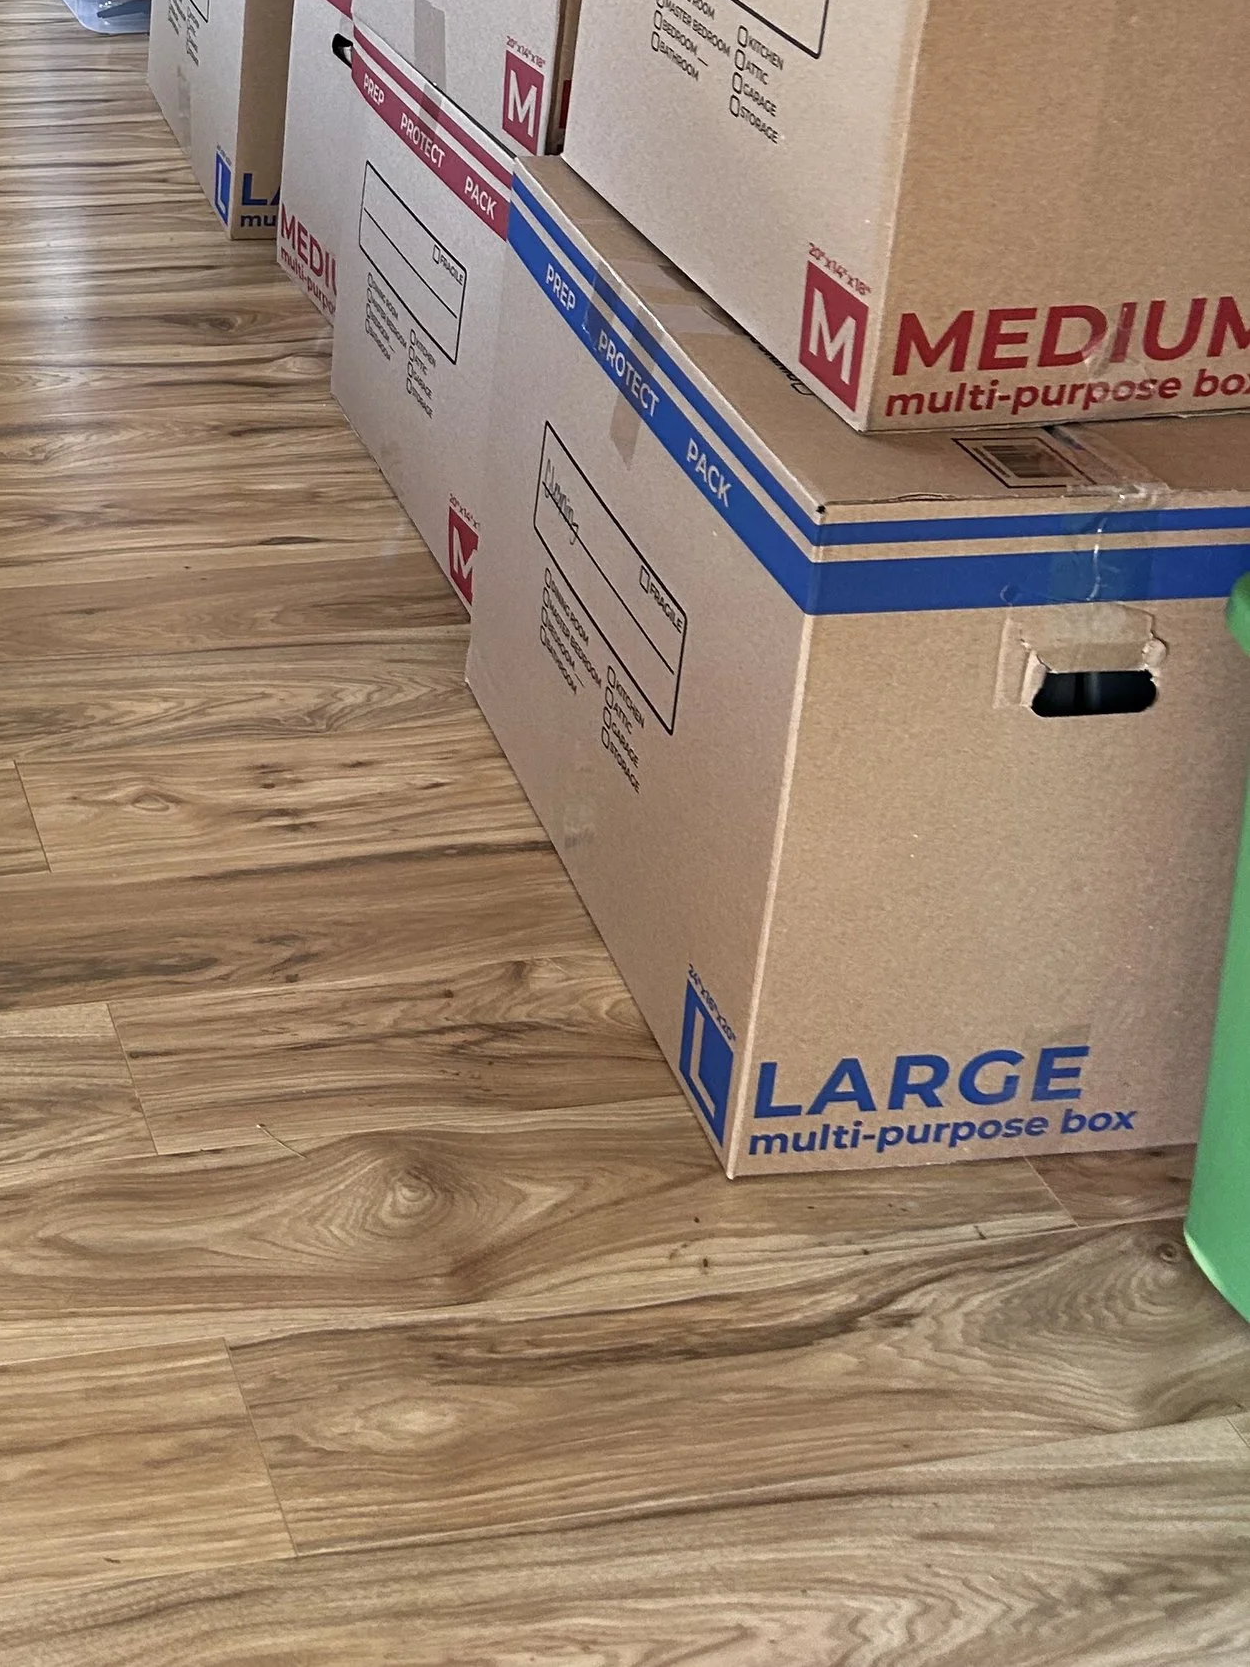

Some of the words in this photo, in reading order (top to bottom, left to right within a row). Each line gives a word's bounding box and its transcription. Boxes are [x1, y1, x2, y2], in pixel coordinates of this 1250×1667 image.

[659, 40, 700, 82] BATHROOM
[662, 18, 699, 56] BEDROOM
[692, 20, 731, 57] BEDROOM
[748, 37, 784, 71] KITCHEN
[745, 61, 769, 85] ATTIC
[507, 69, 538, 138] M
[743, 83, 777, 118] GARAGE
[363, 73, 385, 106] PREP
[400, 112, 446, 168] PROTECT
[464, 175, 498, 221] PACK
[740, 105, 779, 145] STORAGE
[241, 173, 281, 206] L
[808, 287, 856, 385] M
[892, 295, 1250, 376] MEDIUM
[546, 262, 576, 312] PREP
[598, 328, 661, 418] PROTECT
[686, 437, 733, 509] PACK
[885, 375, 1182, 417] multi-purpose
[1192, 368, 1250, 398] bo
[650, 582, 683, 634] FRAGILE
[613, 702, 632, 735] ATTIC
[615, 679, 645, 729] KITCHEN
[609, 740, 641, 795] STORAGE
[611, 722, 640, 770] GARAGE
[689, 1006, 716, 1120] L
[753, 1045, 1091, 1119] LARGE
[748, 1115, 1049, 1156] multi-purpose
[1060, 1108, 1138, 1135] box
